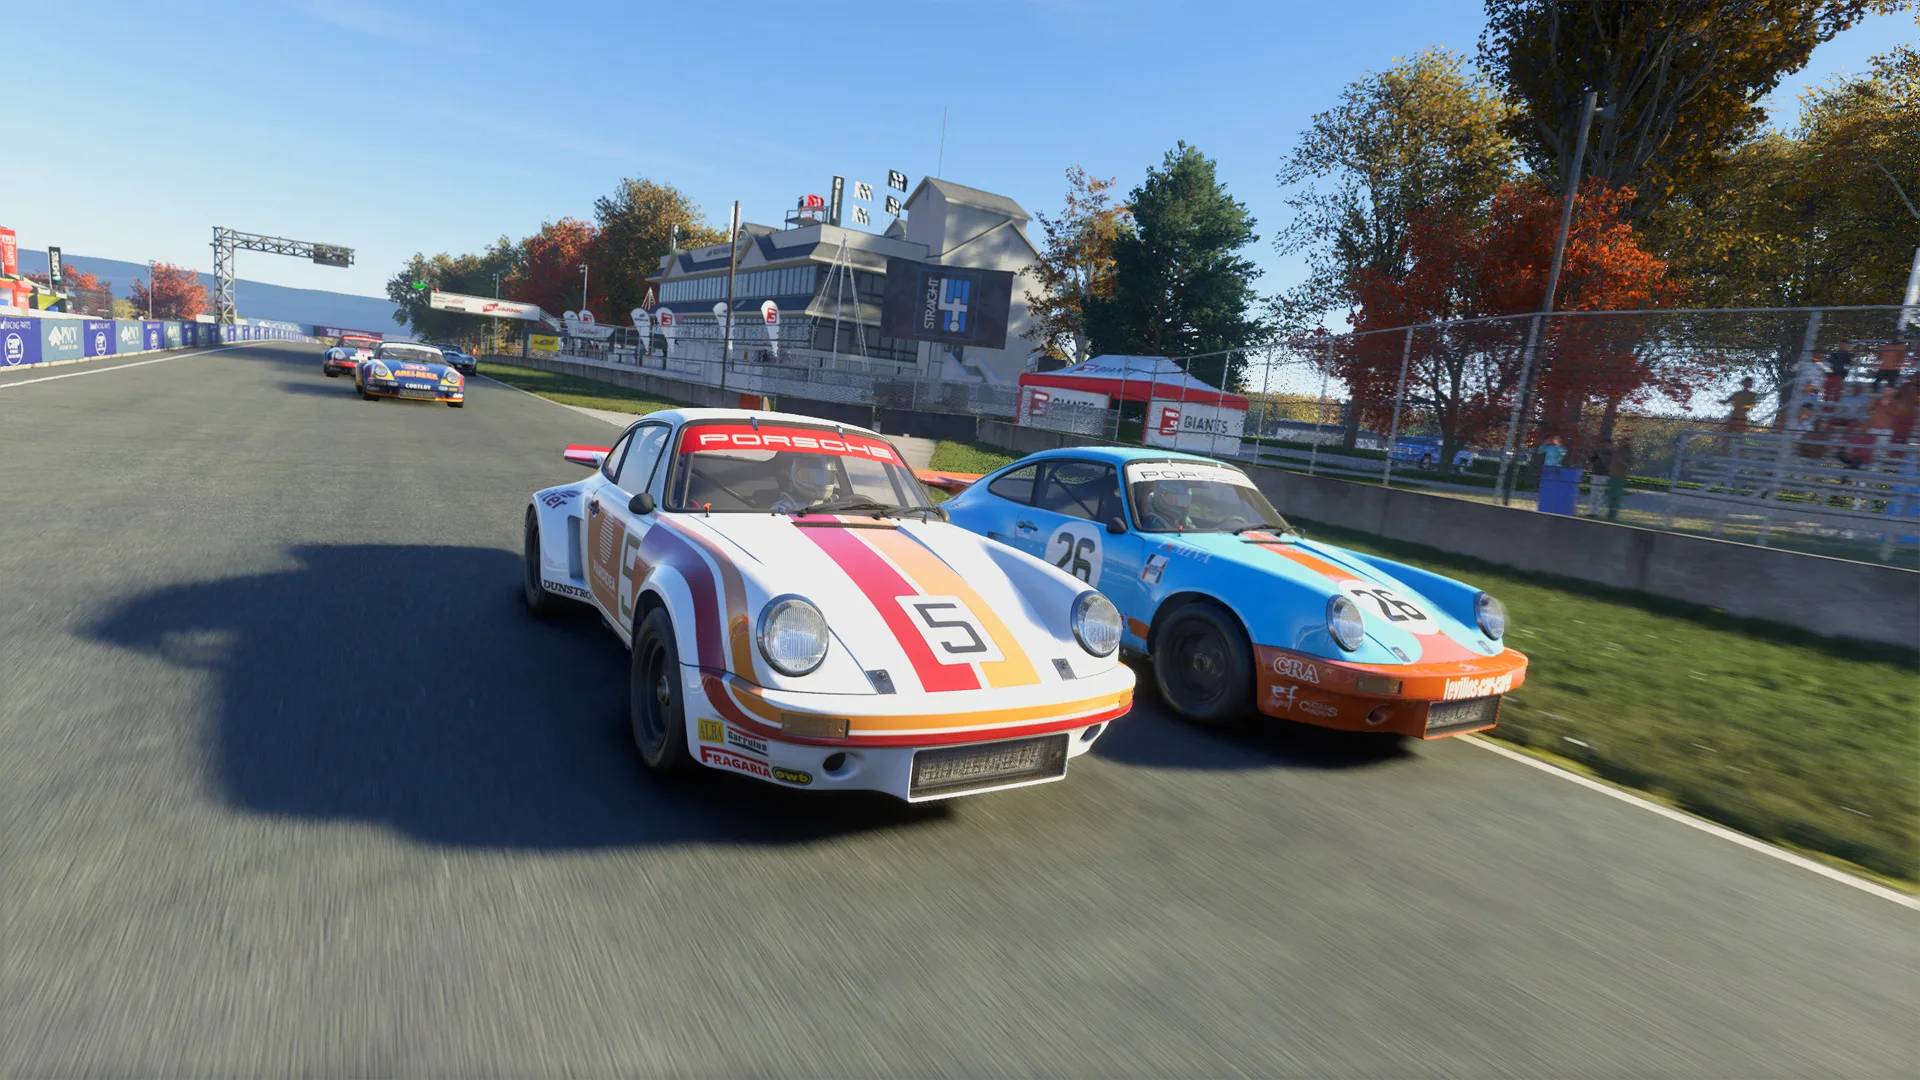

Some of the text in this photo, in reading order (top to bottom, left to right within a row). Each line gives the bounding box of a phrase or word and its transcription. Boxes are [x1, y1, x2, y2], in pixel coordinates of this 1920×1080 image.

[924, 277, 939, 330] STRAIGHT
[1183, 415, 1229, 434] GIANTS
[699, 433, 894, 461] PORSCHE
[1056, 531, 1096, 584] 26
[1351, 589, 1428, 622] 26
[912, 603, 988, 654] 5
[1273, 656, 1320, 684] CRA
[699, 722, 724, 743] ALBA
[700, 745, 773, 779] FRAGARIA
[775, 770, 809, 783] owb
